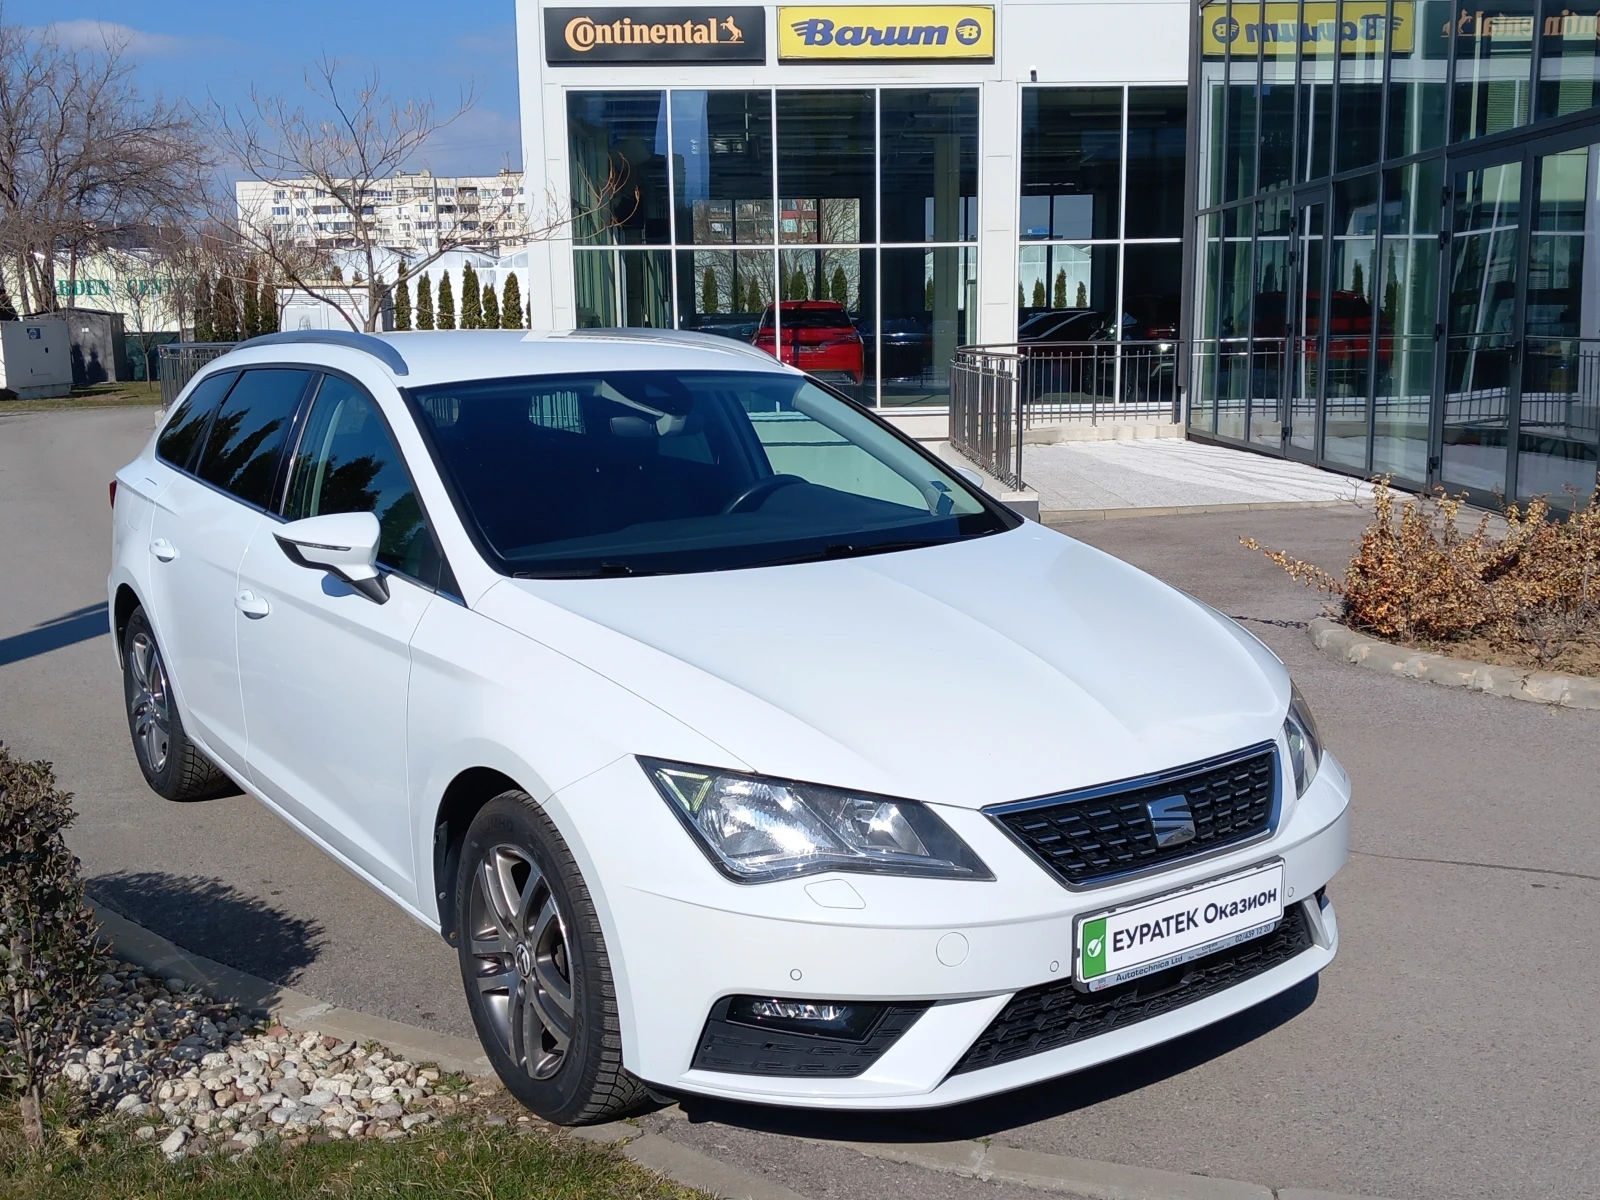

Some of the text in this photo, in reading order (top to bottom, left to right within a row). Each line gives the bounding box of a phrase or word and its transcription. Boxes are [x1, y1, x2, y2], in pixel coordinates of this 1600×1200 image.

[564, 16, 719, 51] Continental
[791, 18, 949, 46] Barum
[1113, 908, 1199, 952] ЕУРАТЕК
[1203, 888, 1277, 924] Оказион
[1116, 955, 1183, 982] Autotechnica Ltd
